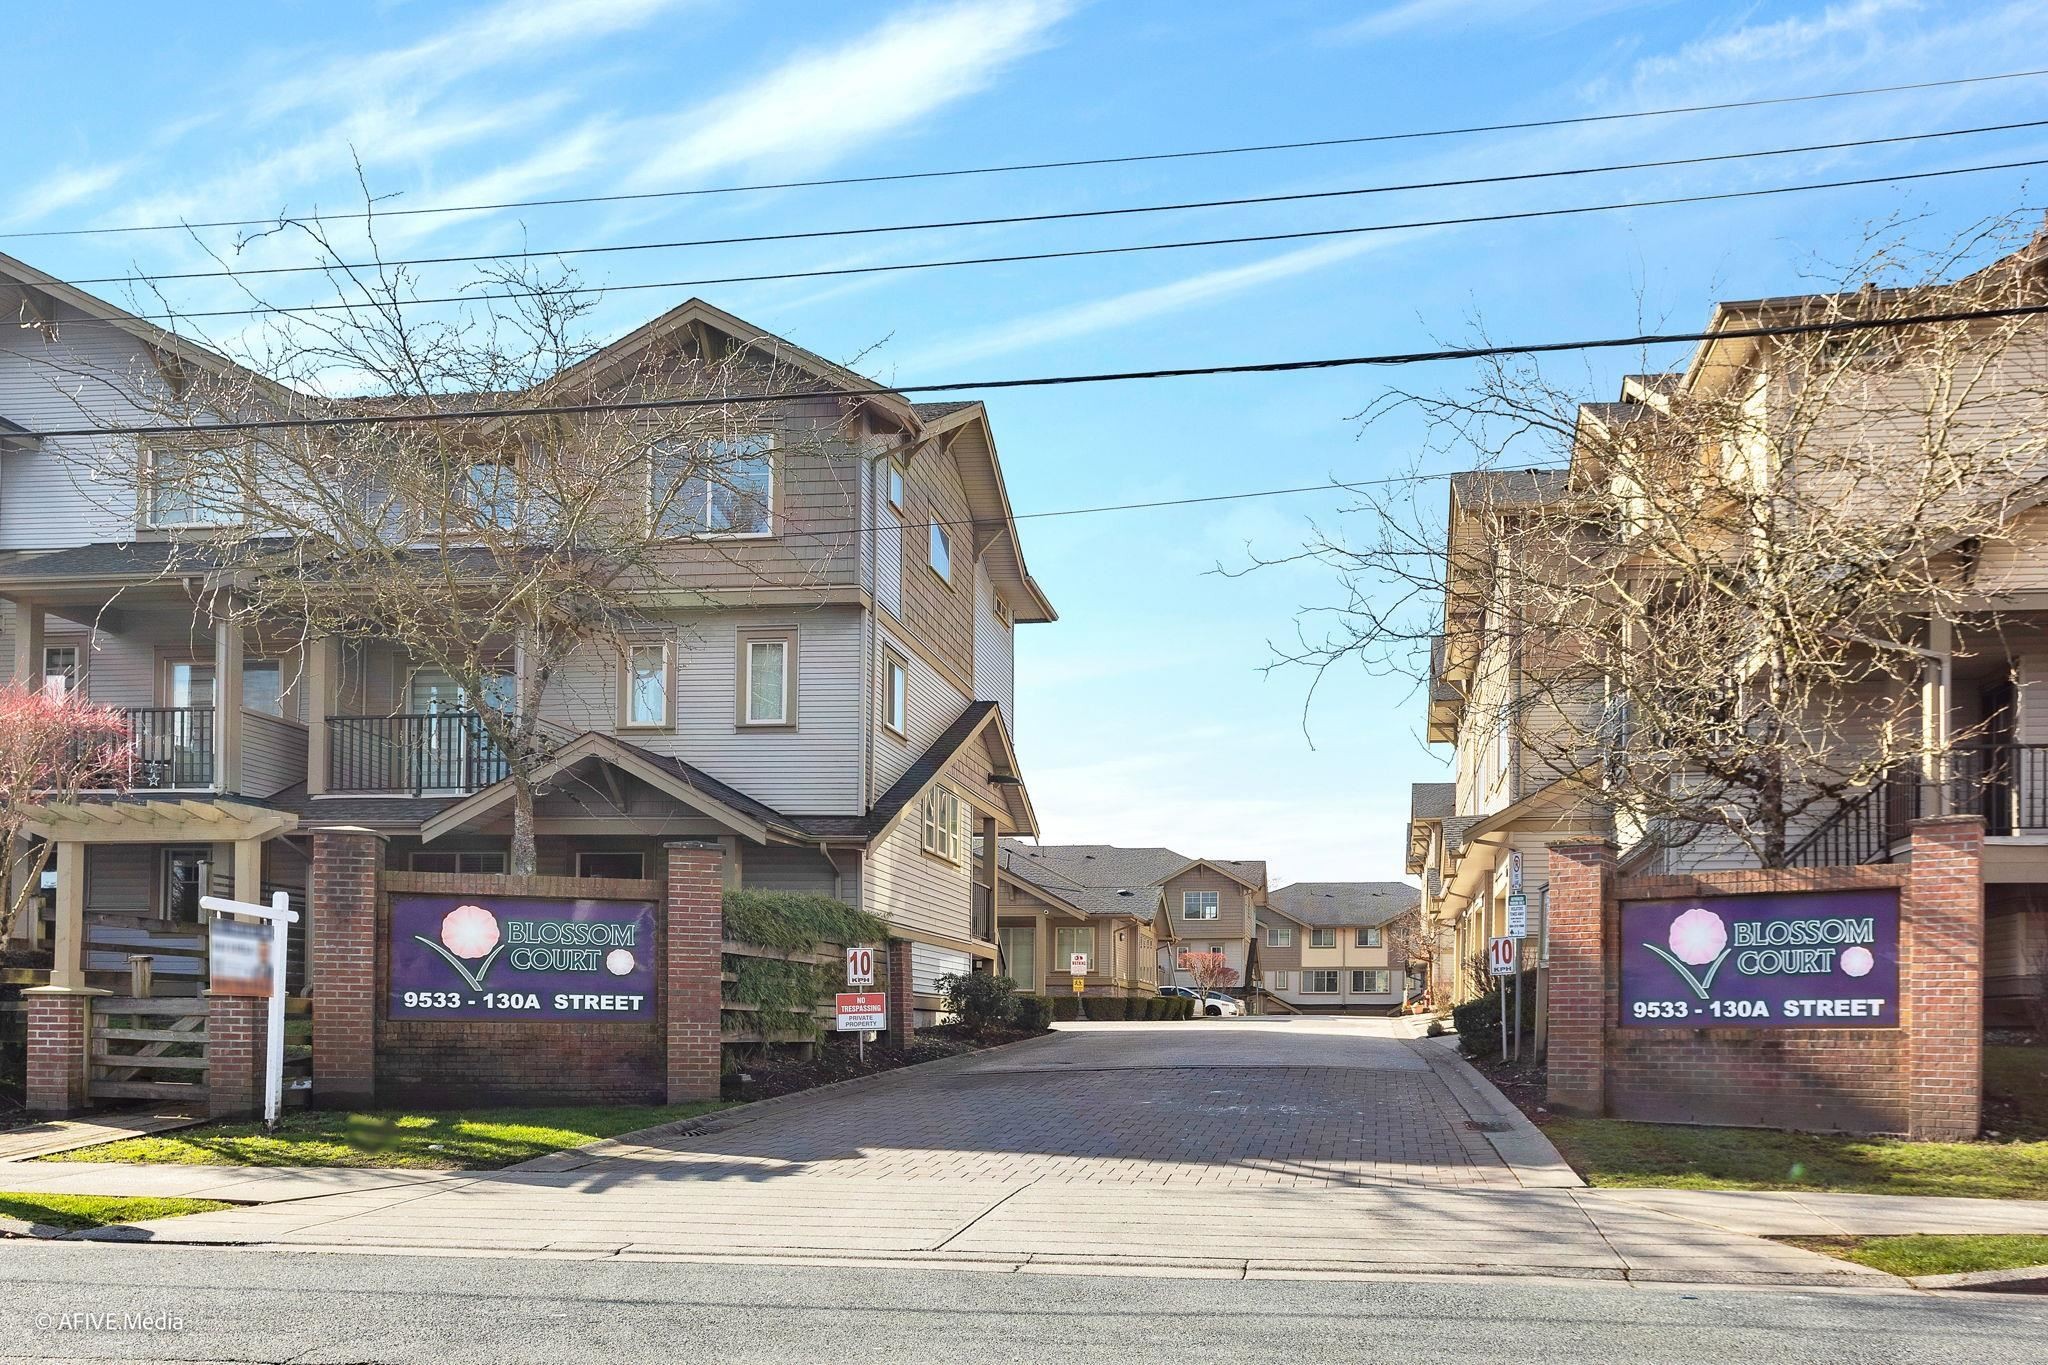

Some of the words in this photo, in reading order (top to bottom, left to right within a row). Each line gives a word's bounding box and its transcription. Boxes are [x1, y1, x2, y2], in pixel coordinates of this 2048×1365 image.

[507, 921, 636, 946] BLOSSOM
[1733, 918, 1875, 946] BLOSSOM
[510, 948, 602, 971] COURT
[850, 951, 871, 975] 10
[1491, 939, 1512, 964] 10
[1737, 948, 1836, 974] COURT
[403, 991, 461, 1008] 9533
[482, 992, 541, 1009] 130A
[554, 994, 644, 1011] STREET
[1633, 1001, 1688, 1018] 9533
[1709, 1000, 1770, 1018] 130A
[1783, 999, 1885, 1017] STREET
